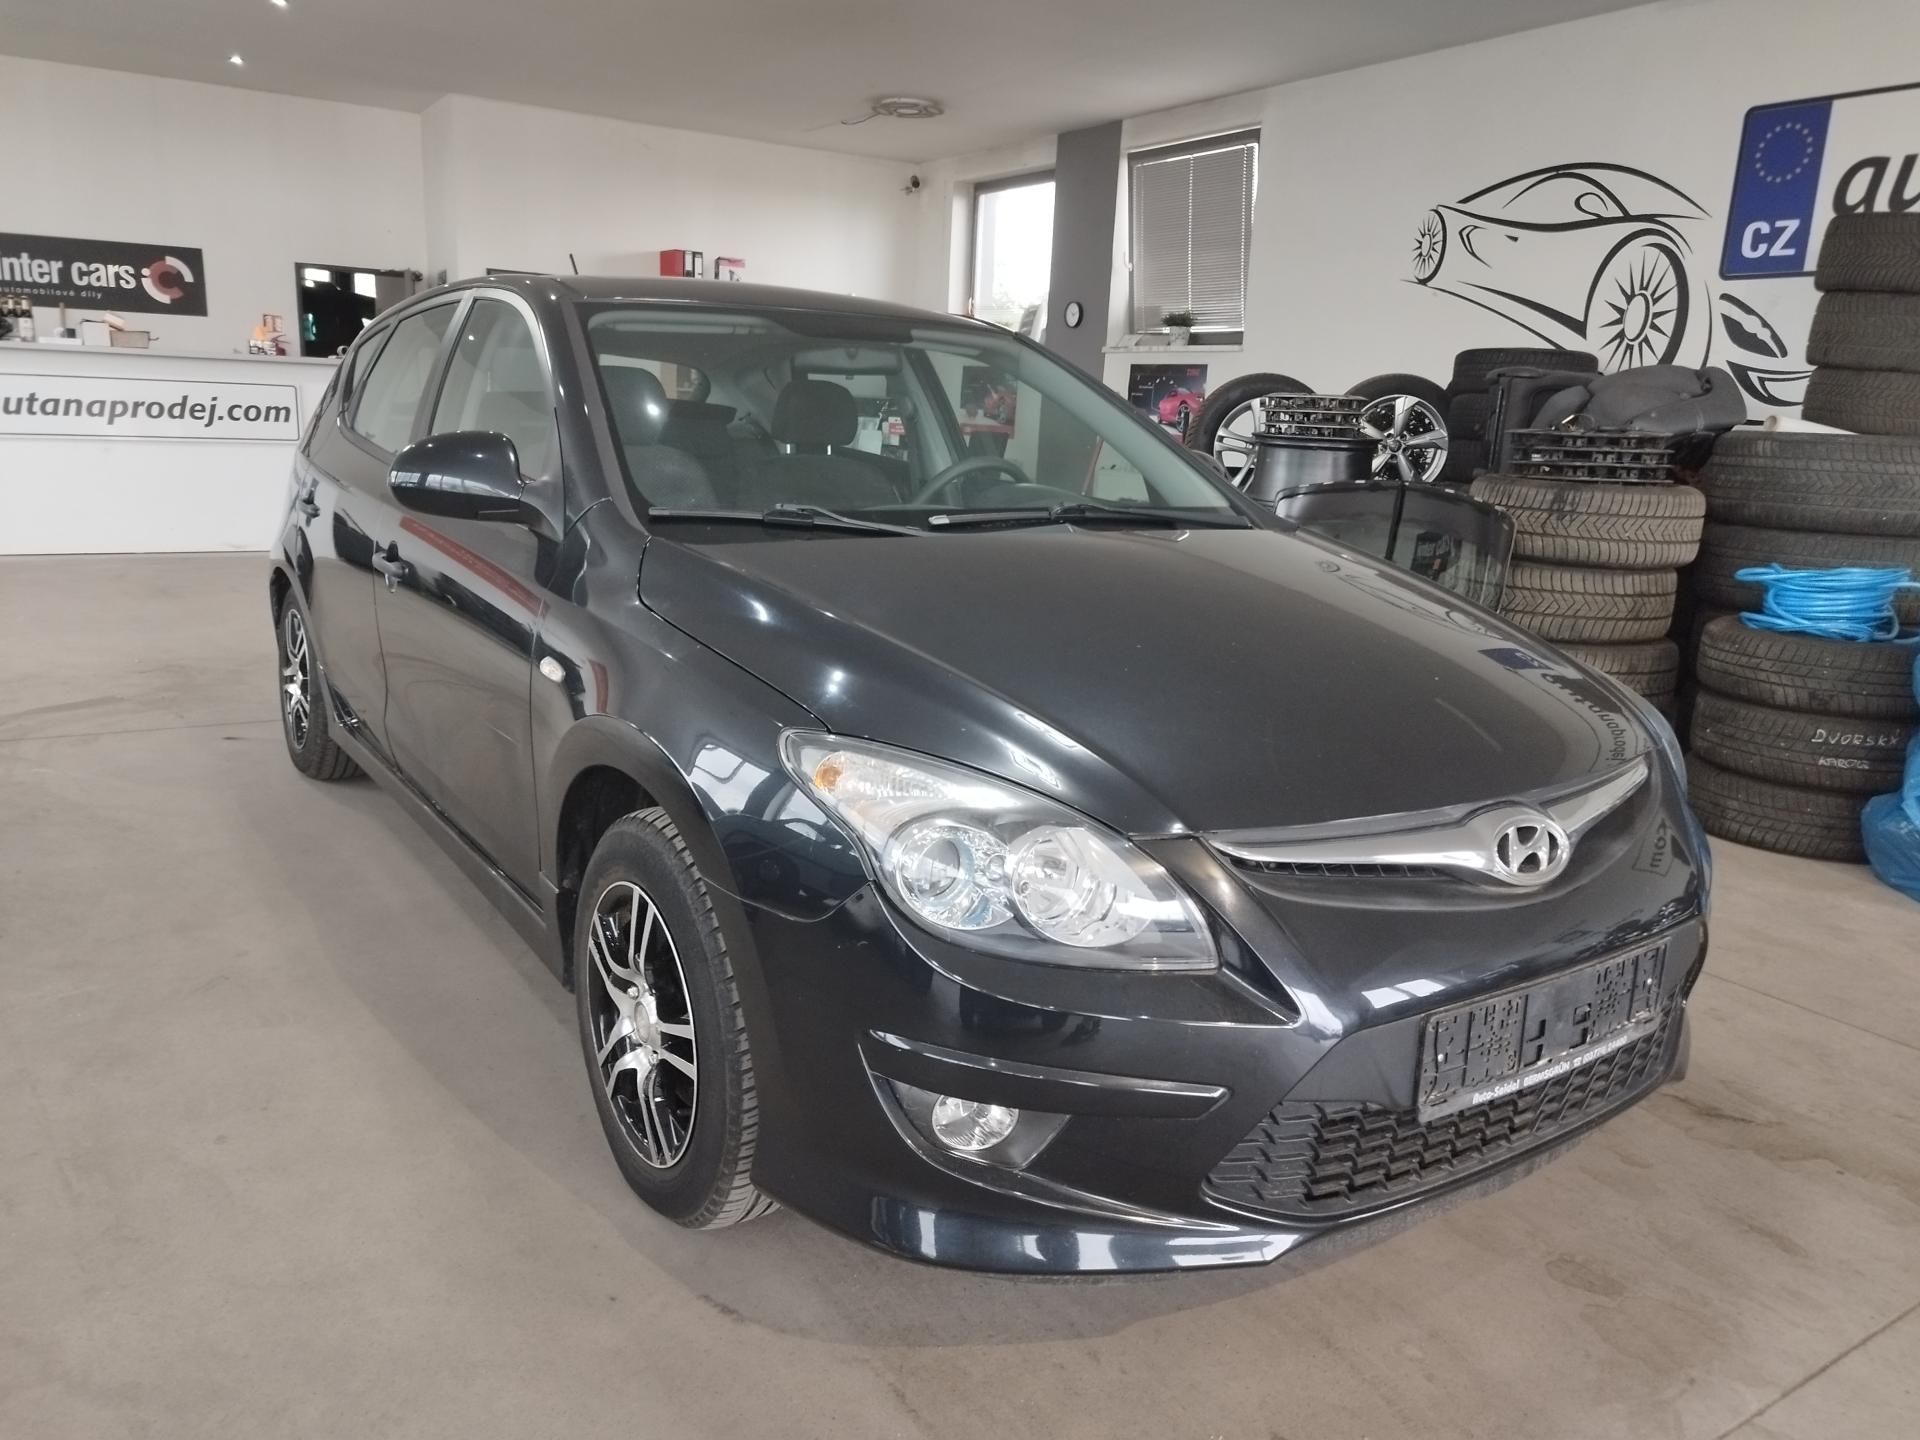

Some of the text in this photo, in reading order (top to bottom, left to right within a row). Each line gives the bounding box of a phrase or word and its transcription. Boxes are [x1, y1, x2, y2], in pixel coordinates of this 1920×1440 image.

[1740, 218, 1801, 259] CZ
[71, 261, 137, 289] cars
[2, 391, 291, 428] utanaprodej.com
